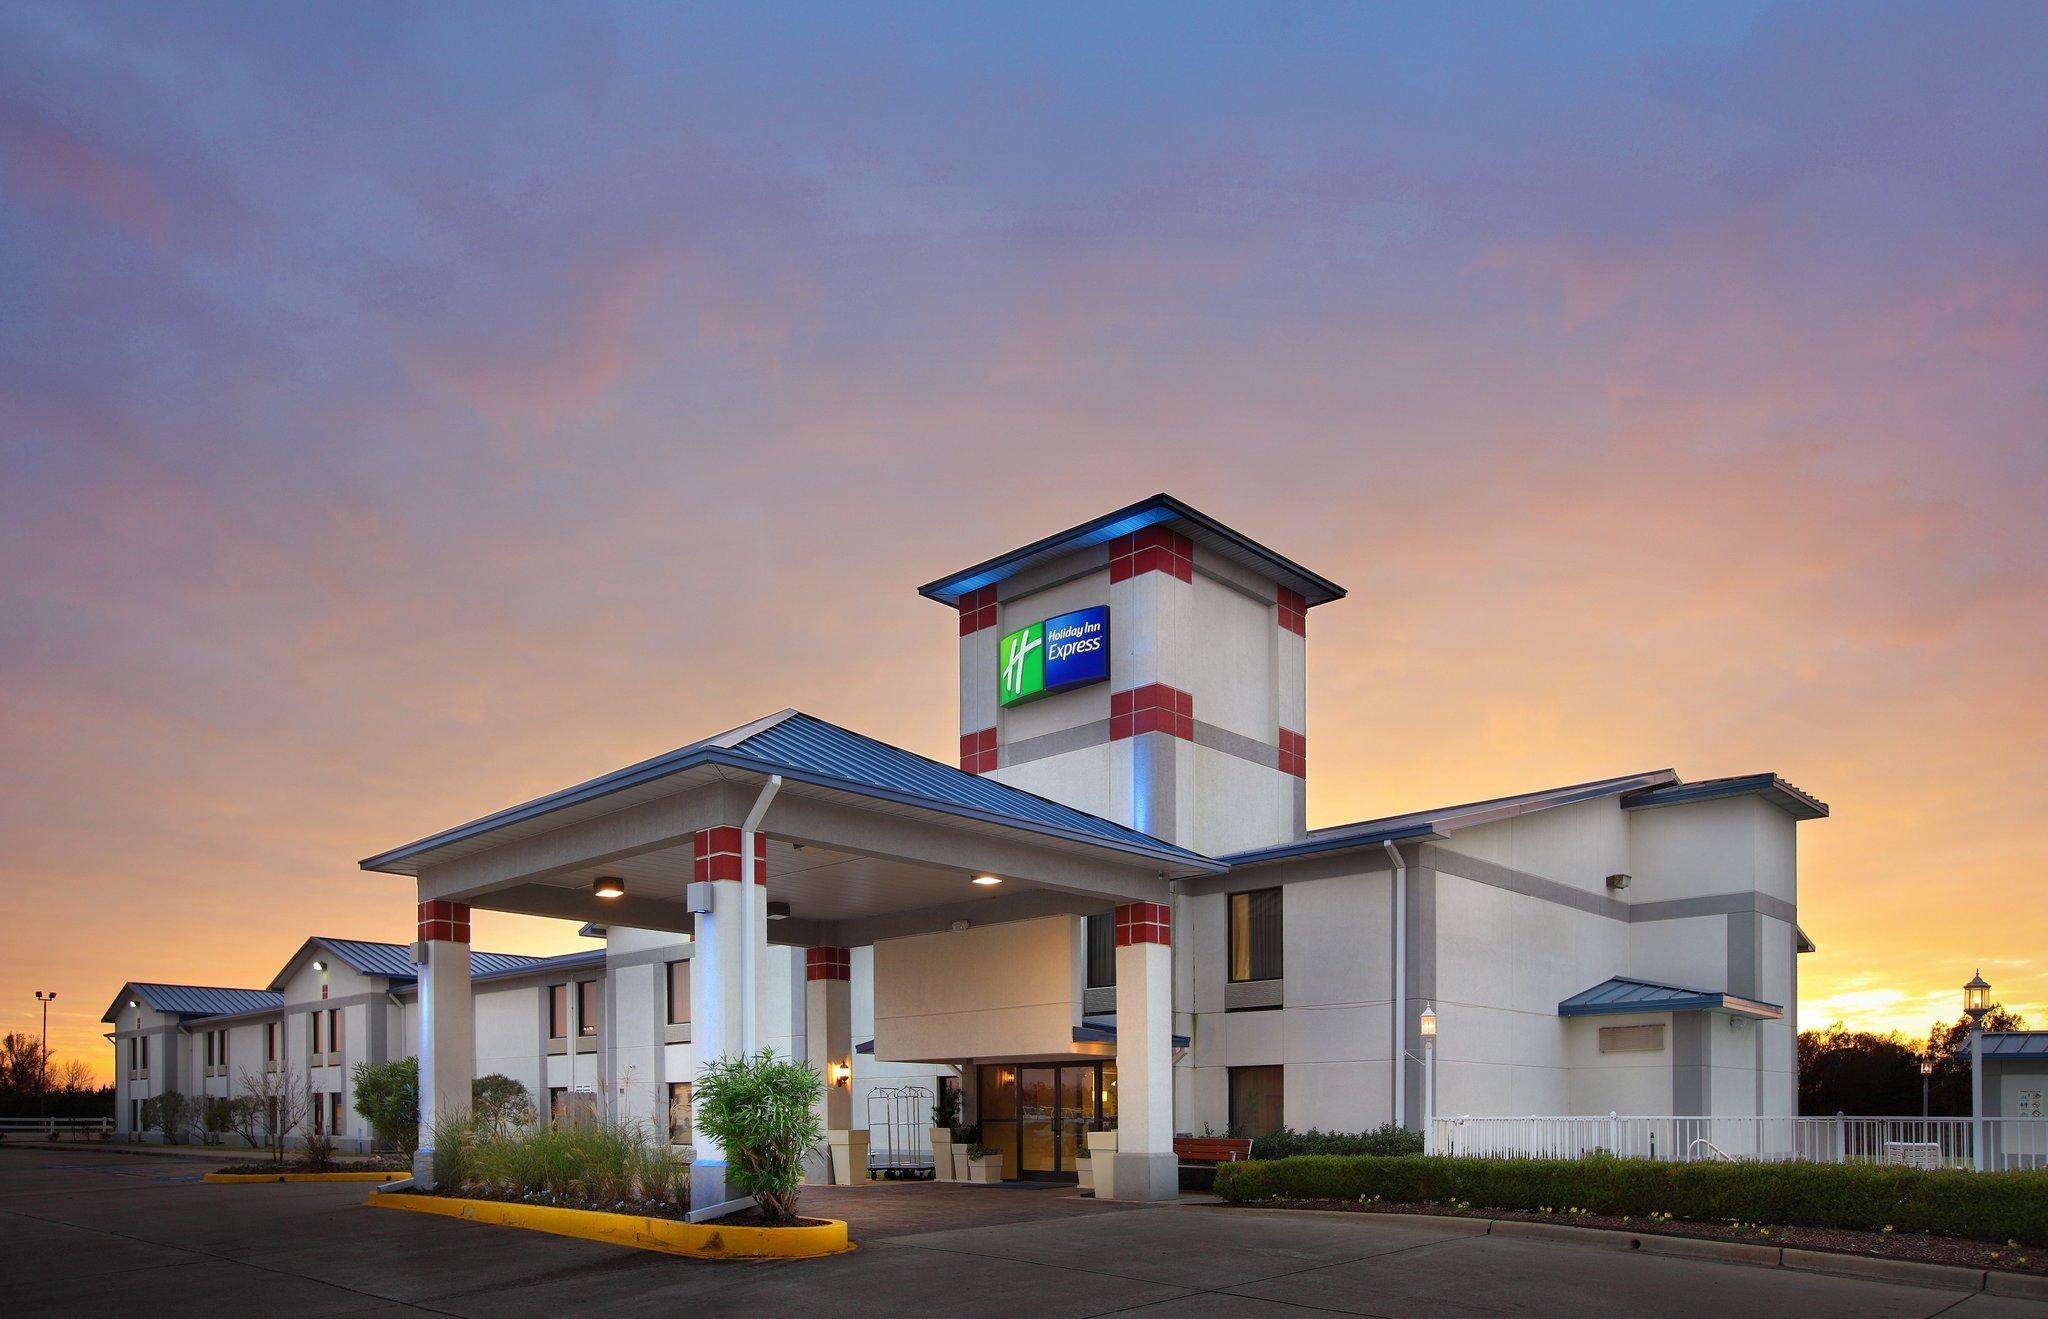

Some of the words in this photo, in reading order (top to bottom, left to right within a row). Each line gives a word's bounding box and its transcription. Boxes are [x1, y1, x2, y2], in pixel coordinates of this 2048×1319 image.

[1048, 626, 1083, 642] Holiday
[1084, 621, 1100, 634] Inn
[1048, 637, 1101, 660] Express
[1002, 629, 1042, 694] H
